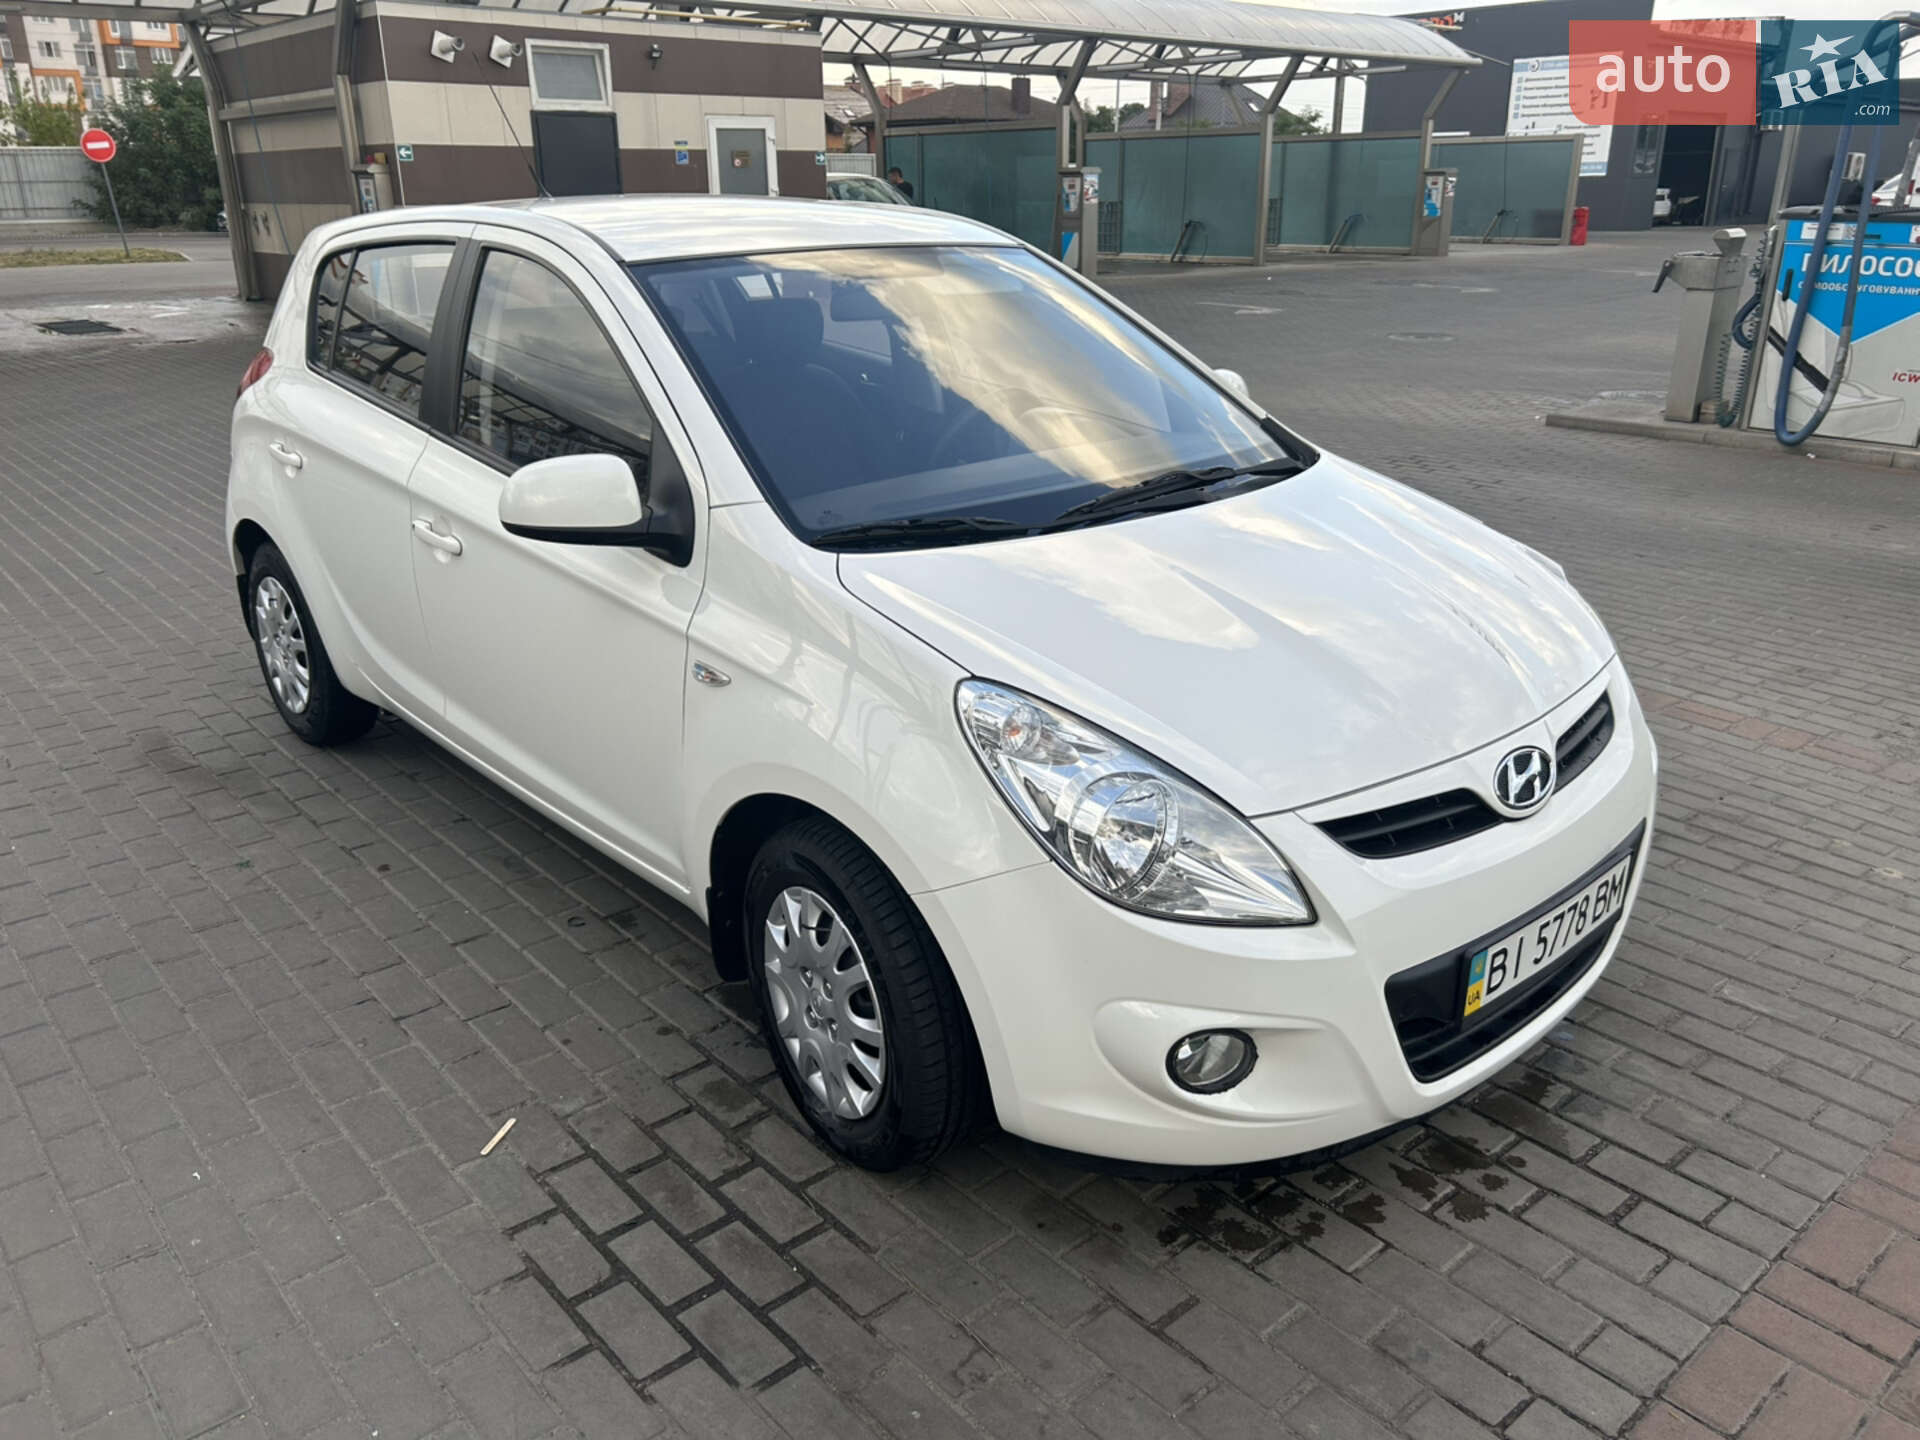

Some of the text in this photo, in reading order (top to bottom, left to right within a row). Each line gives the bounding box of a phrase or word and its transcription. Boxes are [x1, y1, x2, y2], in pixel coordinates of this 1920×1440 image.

[1486, 865, 1626, 996] BI 5778 BM
[1467, 993, 1481, 1006] UA
